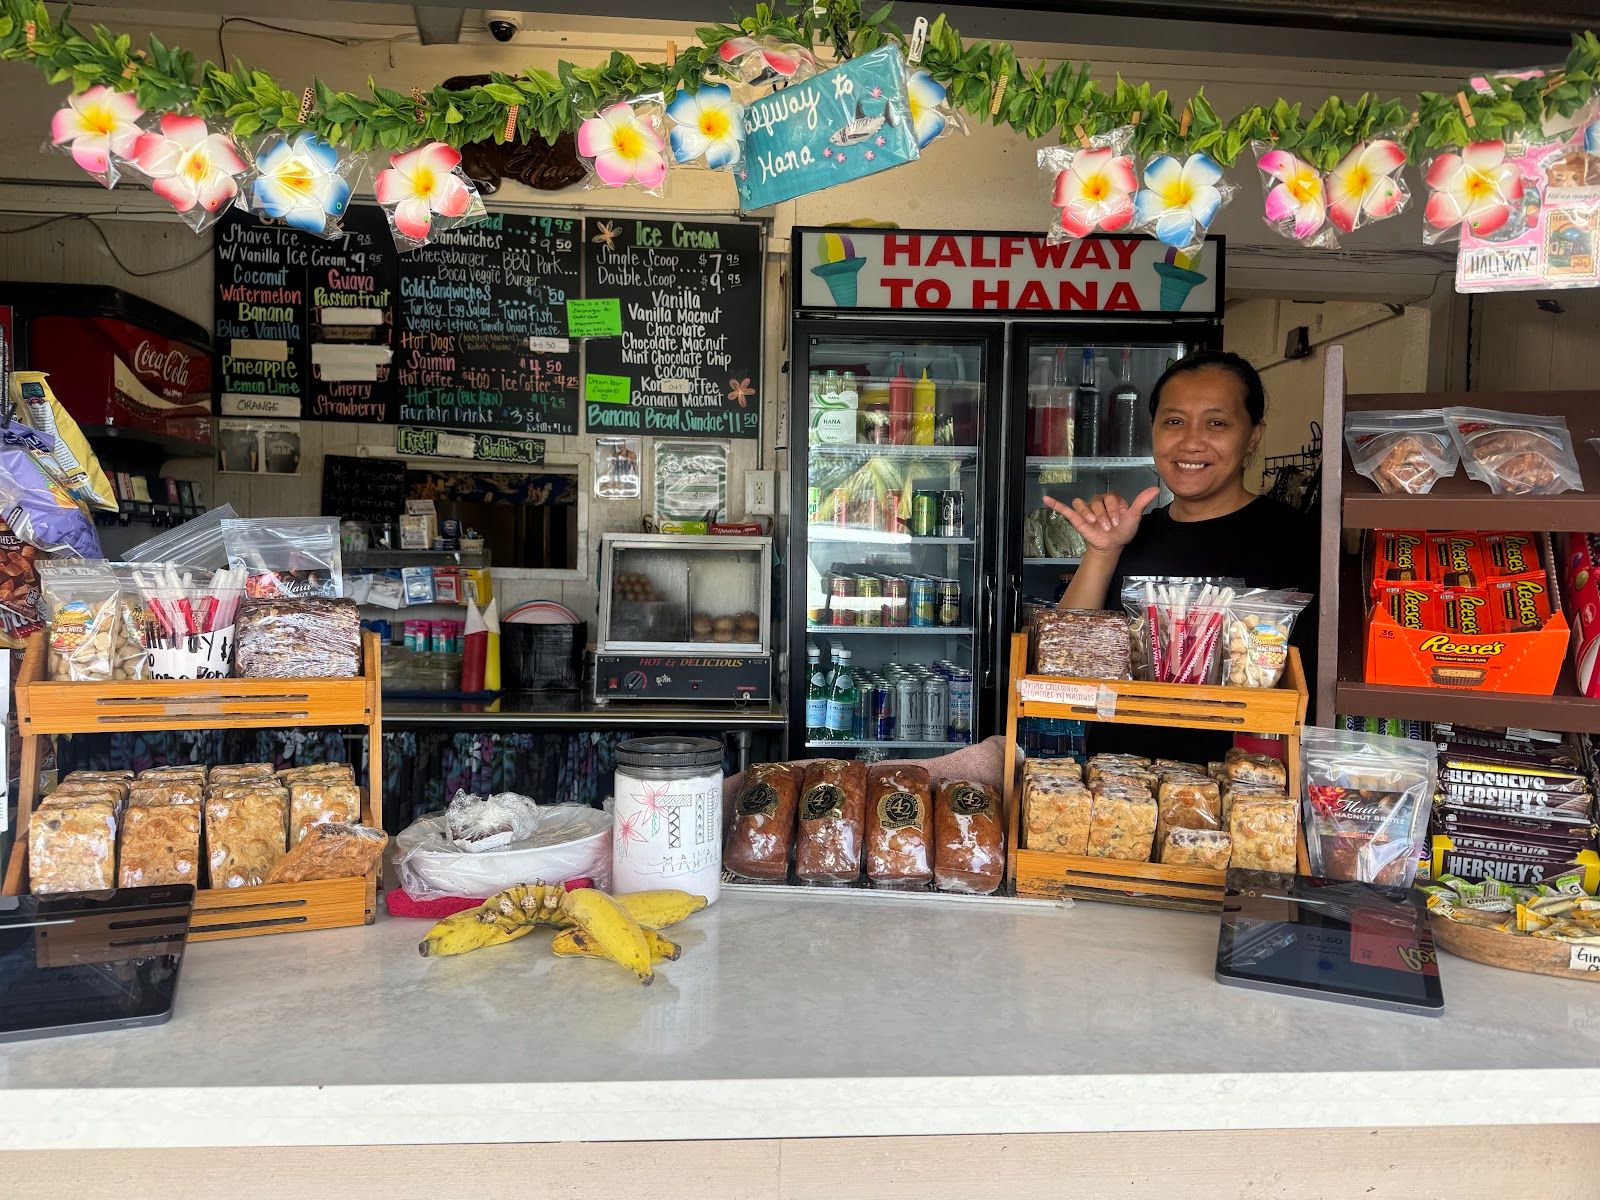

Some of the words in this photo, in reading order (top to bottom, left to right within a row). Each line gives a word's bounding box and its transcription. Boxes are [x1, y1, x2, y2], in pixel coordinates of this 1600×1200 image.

[831, 73, 855, 99] to
[757, 145, 815, 185] Hana
[223, 223, 272, 245] Shave
[277, 229, 300, 247] Ice
[636, 221, 662, 247] Ice
[672, 222, 720, 249] Cream
[287, 246, 308, 266] Ice
[311, 248, 346, 267] Cream
[412, 250, 488, 267] Cheeseburger
[502, 252, 530, 273] BBQ
[537, 254, 564, 275] Pork
[596, 245, 640, 272] Single
[643, 249, 679, 271] Scoop
[883, 234, 1142, 270] HALFWAY
[233, 264, 289, 286] Coconut
[328, 269, 374, 291] Guava
[438, 265, 467, 282] Boca
[469, 270, 501, 286] Veggie
[506, 271, 541, 287] Burger
[598, 267, 642, 286] Double
[643, 267, 677, 288] Scoop
[220, 284, 301, 304] Watermelon
[652, 289, 701, 309] Vanilla
[880, 278, 951, 309] TO
[972, 279, 1142, 312] HANA
[239, 302, 294, 322] Banana
[404, 300, 442, 318] Turkey
[448, 300, 466, 318] Egg
[467, 299, 491, 318] Salad
[528, 303, 554, 323] Fish
[628, 303, 672, 323] Vanilla
[677, 306, 723, 324] Macnut
[217, 319, 250, 338] Blue
[254, 323, 300, 340] Vanilla
[646, 322, 707, 338] Chocolate
[400, 331, 428, 349] Hot
[430, 333, 455, 353] Dogs
[622, 331, 678, 351] Chocolate
[683, 334, 728, 351] Macnut
[222, 355, 299, 378] Pineapple
[407, 352, 456, 372] Saimin
[622, 350, 650, 365] Mint
[651, 351, 702, 366] Chocolate
[706, 351, 732, 372] Chip
[225, 376, 265, 393] Lemon
[268, 377, 300, 394] Lime
[329, 382, 372, 398] Cherry
[400, 369, 419, 387] Hot
[421, 371, 454, 389] Coffee
[501, 372, 518, 391] Ice
[641, 376, 664, 392] Kon
[688, 378, 720, 394] offee
[237, 399, 279, 411] ORANGE
[313, 395, 386, 421] Strawberry
[406, 388, 432, 407] Hot
[435, 388, 456, 407] Tea
[631, 390, 678, 407] Banana
[682, 393, 724, 407] Macnut
[400, 404, 451, 422] Fountain
[455, 406, 494, 424] Drinks
[588, 404, 640, 428] Banana
[645, 408, 680, 431] Bread
[681, 410, 725, 432] Sundae
[823, 418, 842, 426] HANA
[399, 429, 434, 451] FRESH
[479, 437, 520, 458] Smoothie
[1399, 533, 1421, 569] Reese's
[1451, 537, 1474, 573] Reese's
[1504, 535, 1529, 573] Reese's
[1404, 588, 1430, 630] Reese's
[1516, 580, 1545, 627] Reese's
[1460, 594, 1485, 636] Reese's
[1382, 629, 1393, 637] 36
[1420, 635, 1505, 656] Reese's
[640, 658, 662, 667] HOT
[665, 658, 676, 667] &
[680, 658, 744, 668] DELICIOUS
[1449, 769, 1546, 790] HERSHEY'S
[891, 798, 911, 816] 42
[1331, 800, 1381, 815] Maui
[1450, 785, 1549, 813] HERSHEY'S
[1334, 812, 1372, 822] MACNUT
[1449, 855, 1544, 884] HERSHEY'S
